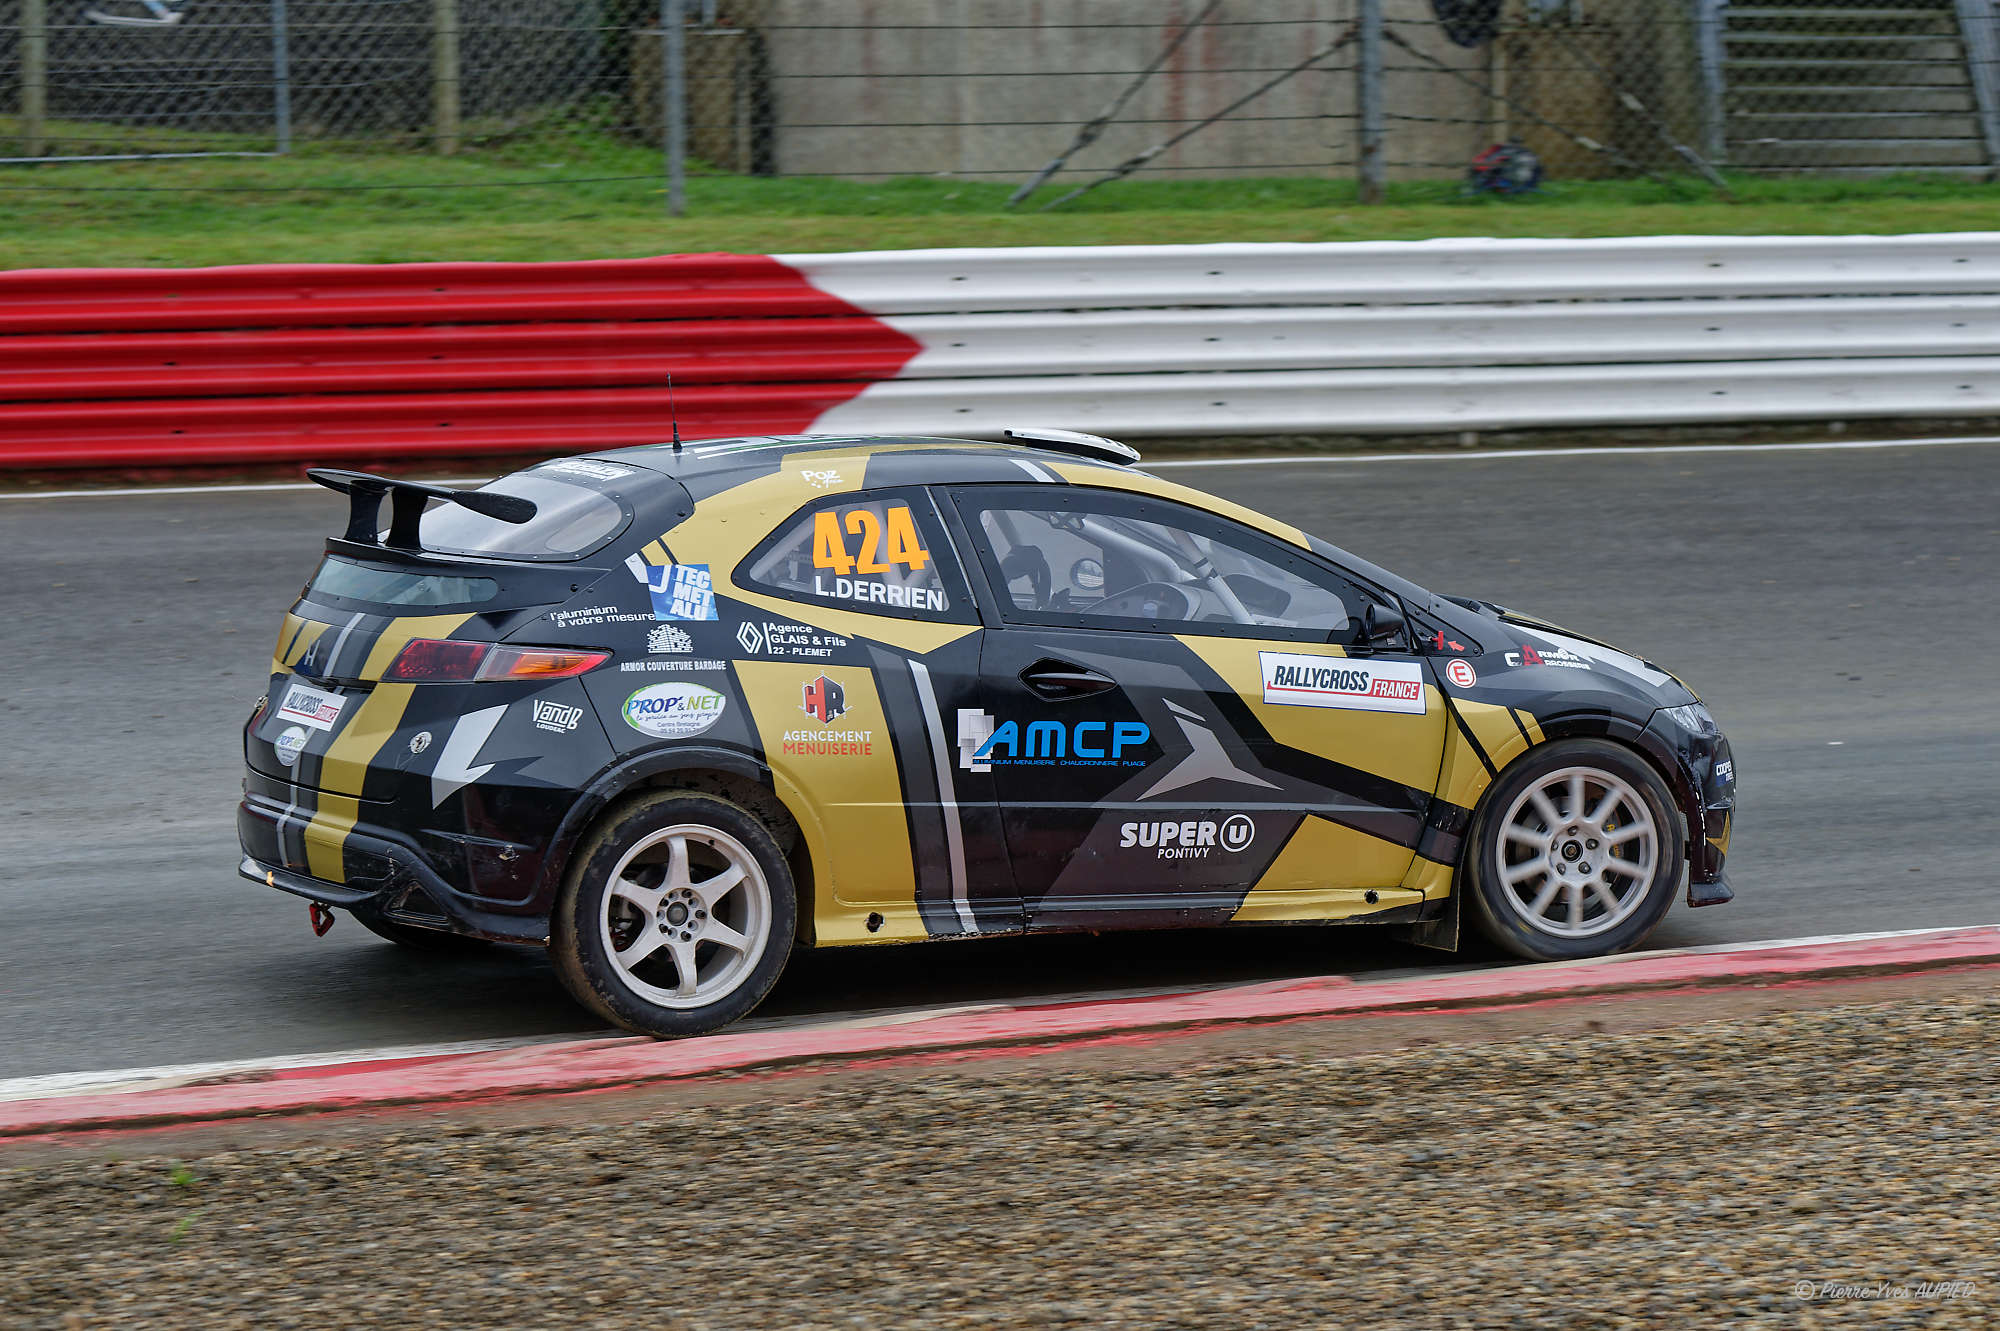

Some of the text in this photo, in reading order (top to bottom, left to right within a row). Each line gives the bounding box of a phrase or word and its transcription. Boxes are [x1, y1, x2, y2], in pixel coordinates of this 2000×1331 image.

[813, 506, 931, 575] 424
[675, 564, 711, 589] TEC
[673, 581, 714, 606] MET
[815, 575, 945, 612] L.DERRIEN
[550, 605, 618, 621] l'aluminium
[670, 599, 707, 619] ALU
[557, 612, 656, 628] à votre mesure
[768, 622, 813, 635] Agence
[770, 635, 847, 647] GLAIS & Fils
[773, 647, 784, 655] 22
[792, 647, 833, 657] PLEMET
[620, 660, 727, 673] ARMOR COUVERTURE BARDAGE
[1454, 663, 1470, 683] E
[1273, 665, 1419, 699] RALLYCROSS FRANCE
[677, 702, 685, 711] &
[687, 695, 721, 711] NET
[532, 699, 584, 730] VandB
[536, 722, 567, 734] LOUDEAC
[783, 730, 873, 742] AGENCEMENT
[973, 720, 1151, 758] AMCP
[783, 742, 873, 756] MENUISERIE
[973, 758, 1012, 766] ALUMINIUM
[1013, 759, 1056, 767] MENUISERIE
[1122, 760, 1147, 768] PLIAGE
[1120, 820, 1248, 848] SUPER U
[1157, 846, 1211, 860] PONTIVY
